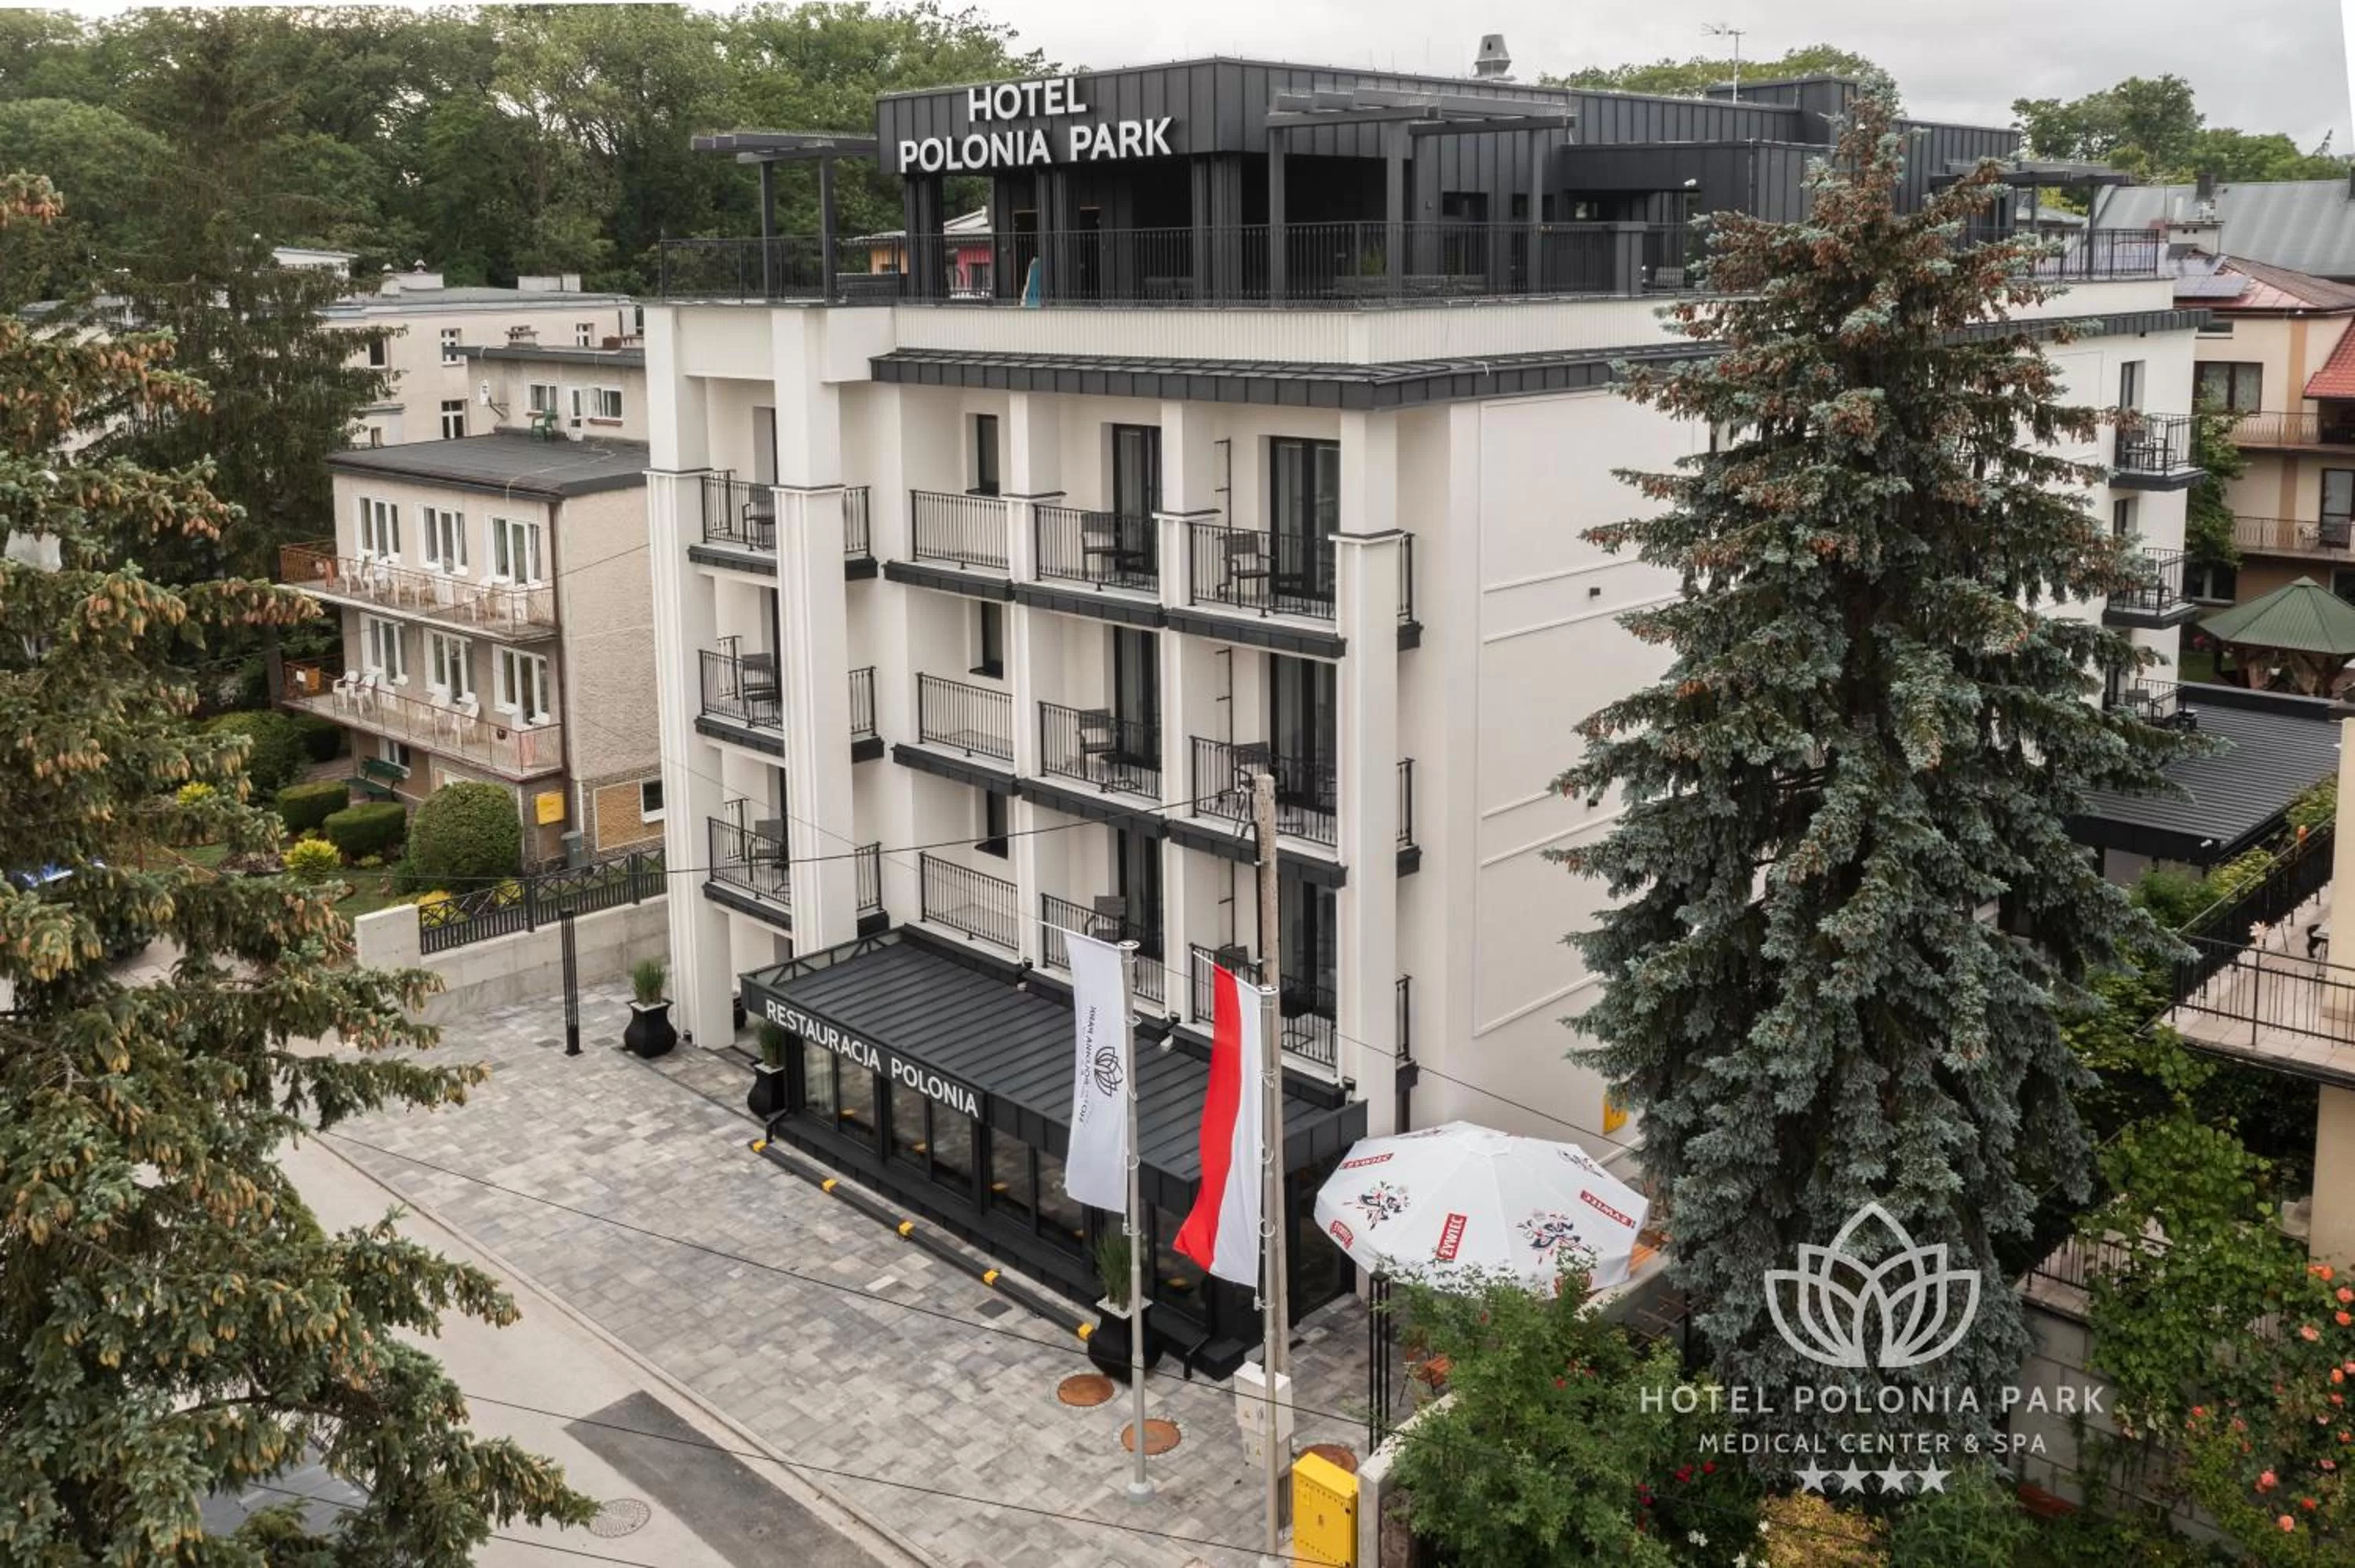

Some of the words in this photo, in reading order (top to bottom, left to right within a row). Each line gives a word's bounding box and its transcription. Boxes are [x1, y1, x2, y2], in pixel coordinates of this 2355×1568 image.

[968, 78, 1087, 122] HOTEL
[900, 129, 1052, 173] POLONIA
[1070, 116, 1173, 162] PARK
[765, 999, 881, 1073] RESTAURACJA
[891, 1056, 979, 1118] POLONIA
